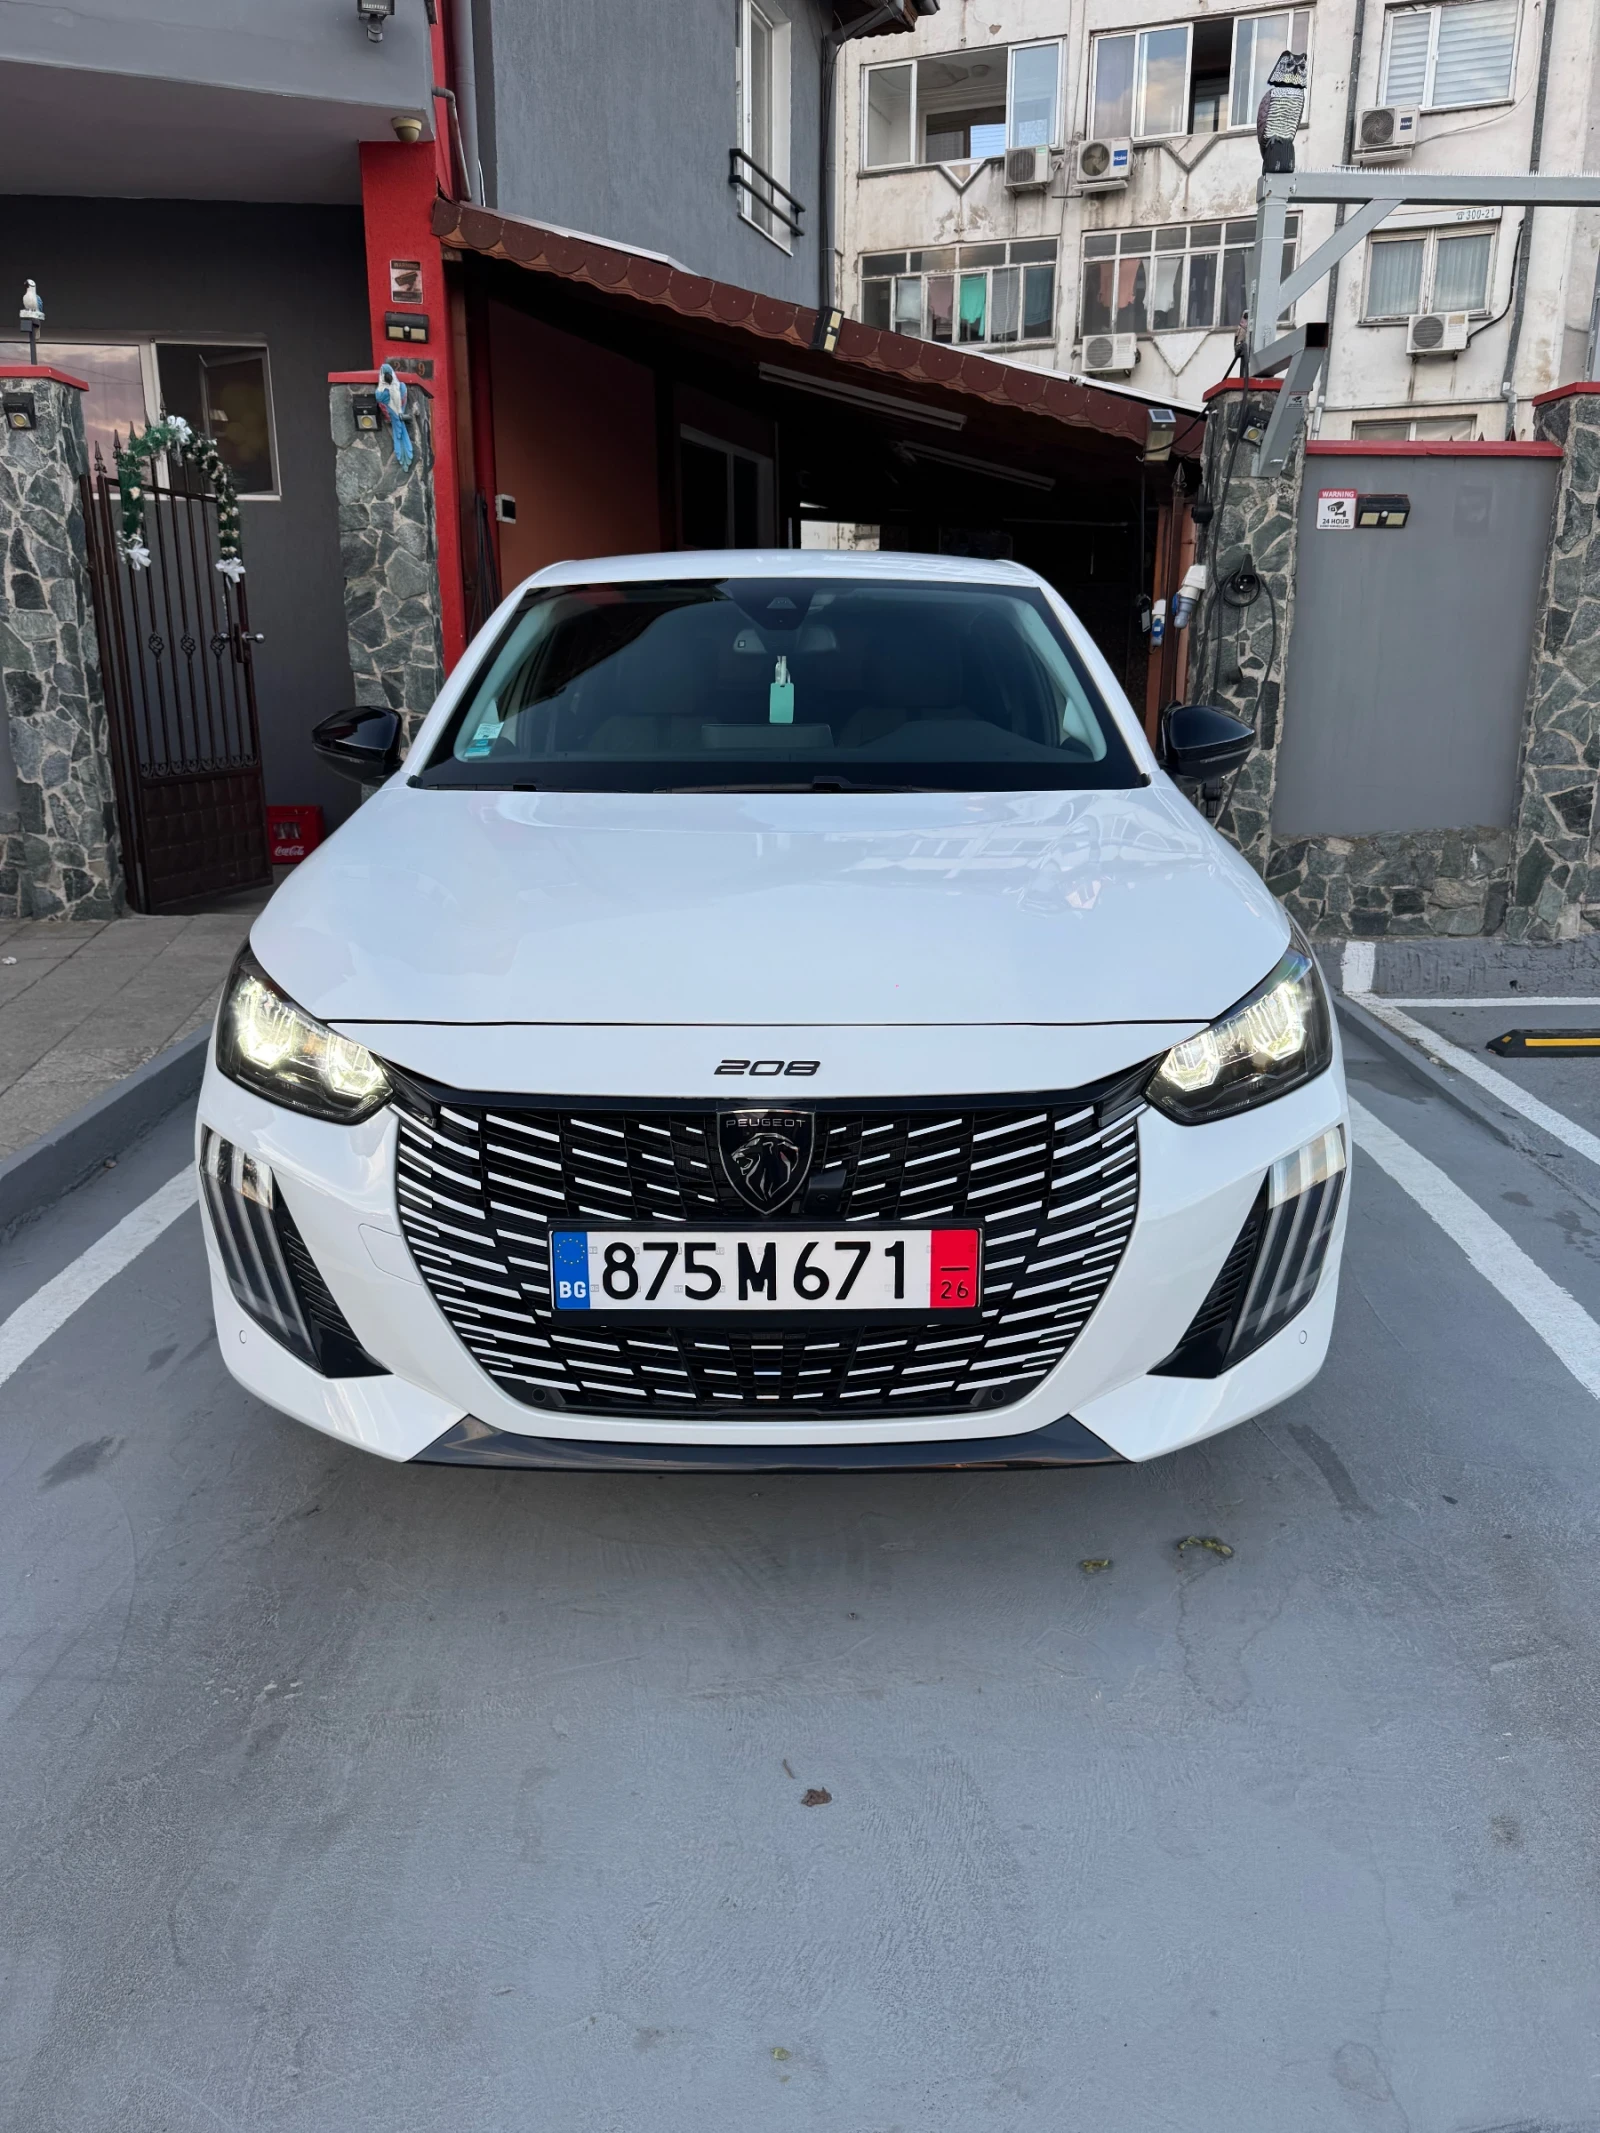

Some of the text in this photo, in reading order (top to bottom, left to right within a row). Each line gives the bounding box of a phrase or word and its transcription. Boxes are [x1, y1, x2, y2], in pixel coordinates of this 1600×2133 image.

[1321, 490, 1355, 498] WARNING
[714, 1059, 821, 1076] 208
[726, 1118, 806, 1128] PEUGEOT
[558, 1280, 587, 1299] BG
[940, 1279, 969, 1300] 26
